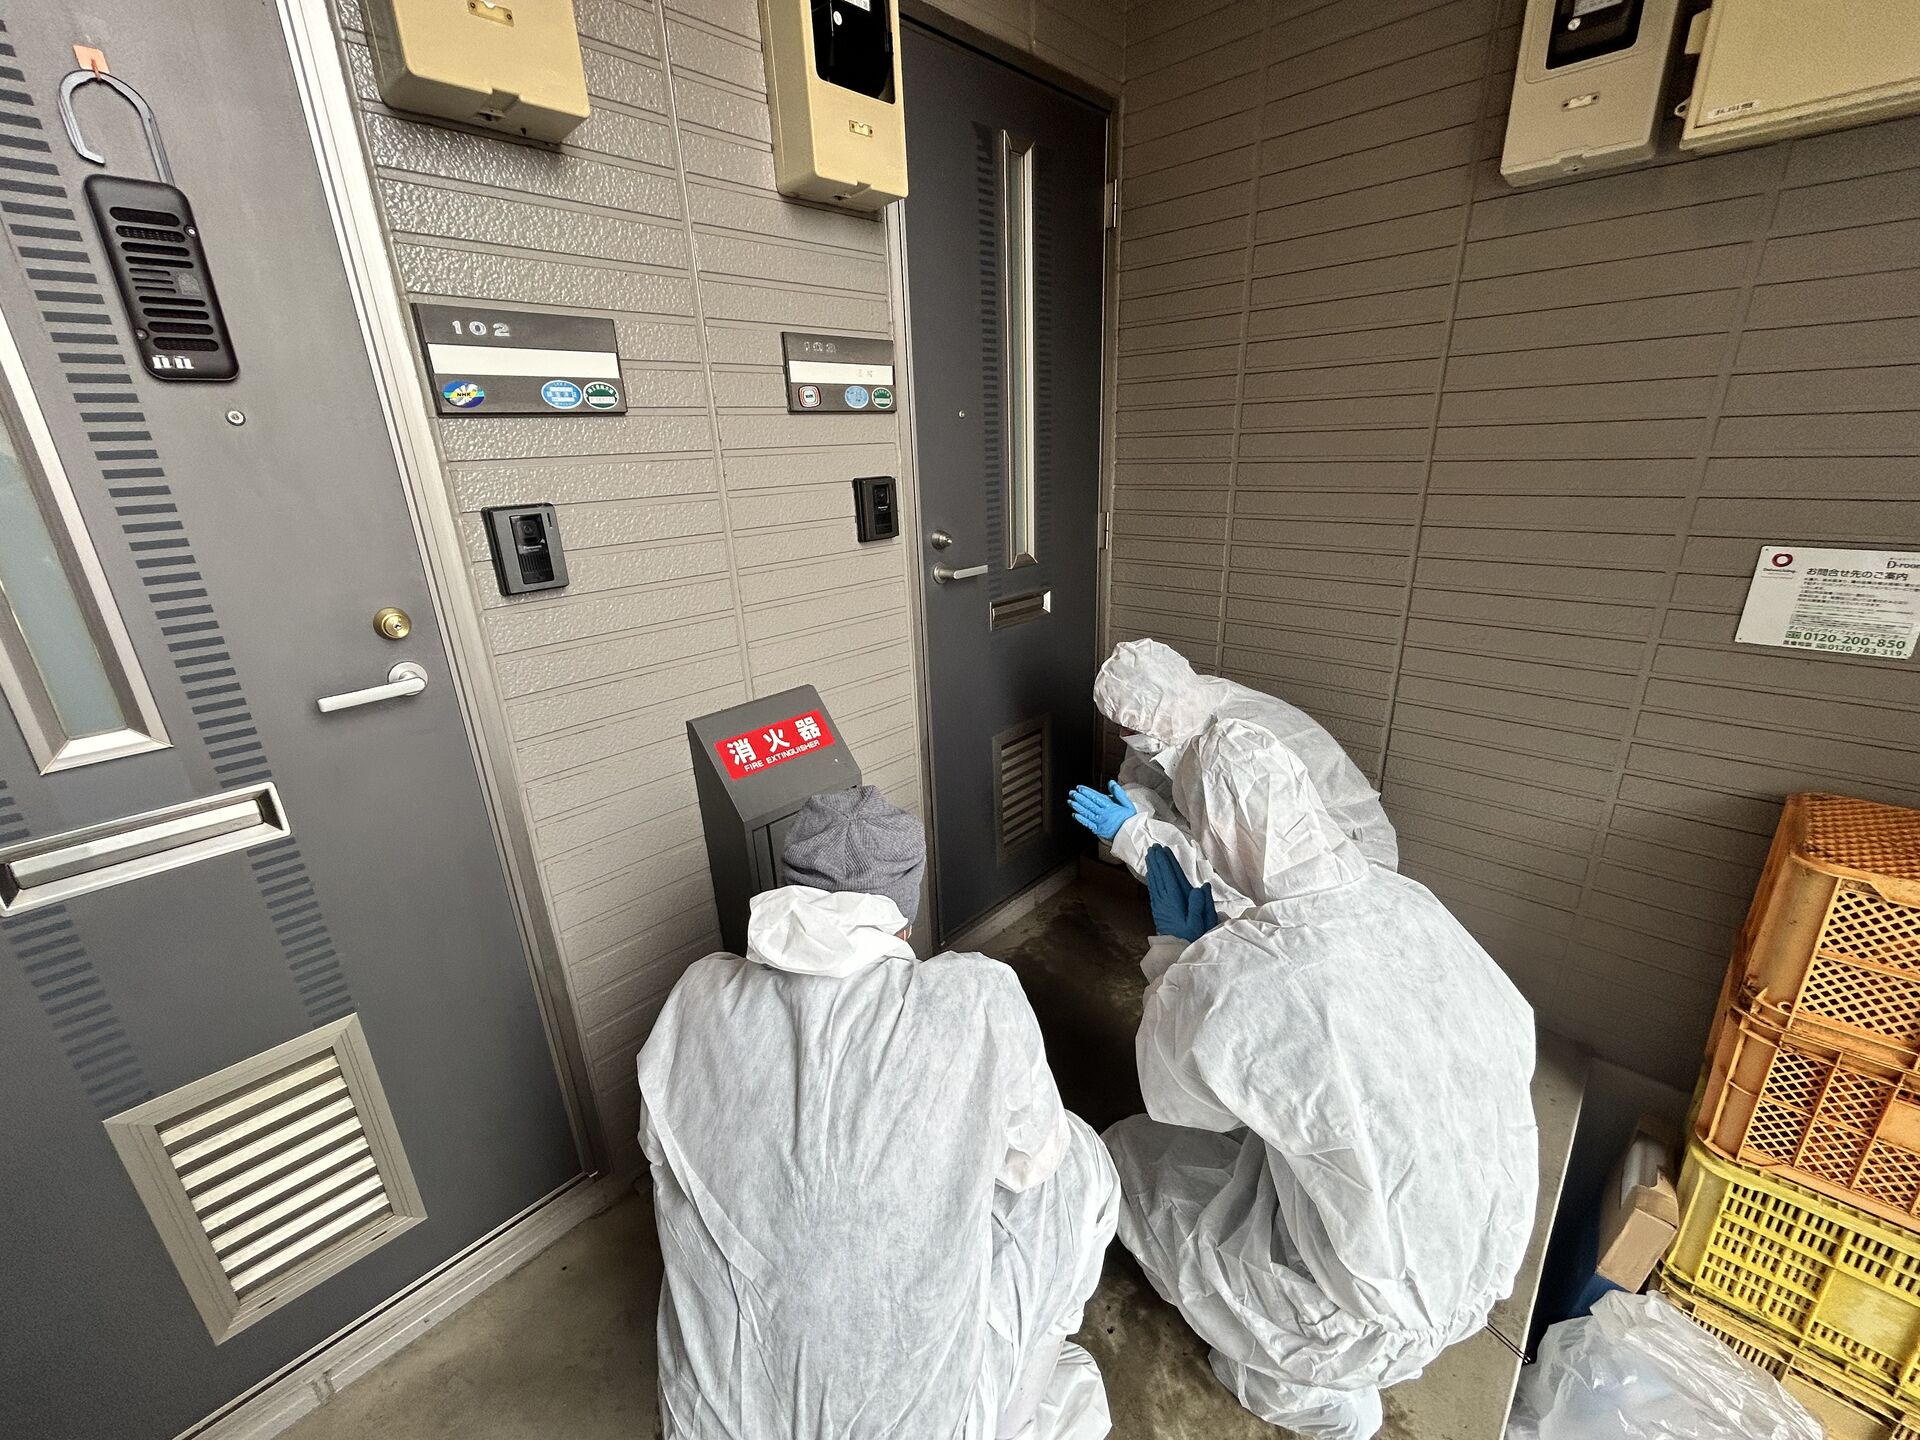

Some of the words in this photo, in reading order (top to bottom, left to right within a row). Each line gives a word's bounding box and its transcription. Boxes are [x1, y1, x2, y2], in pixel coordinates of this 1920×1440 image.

[452, 320, 510, 337] 102
[1806, 567, 1908, 581] お問合せ先のご案内
[1803, 632, 1906, 649] 0120-200-850
[727, 716, 822, 765] 消火器
[744, 760, 765, 772] FIRE
[765, 740, 820, 764] EXTINGUISHER
